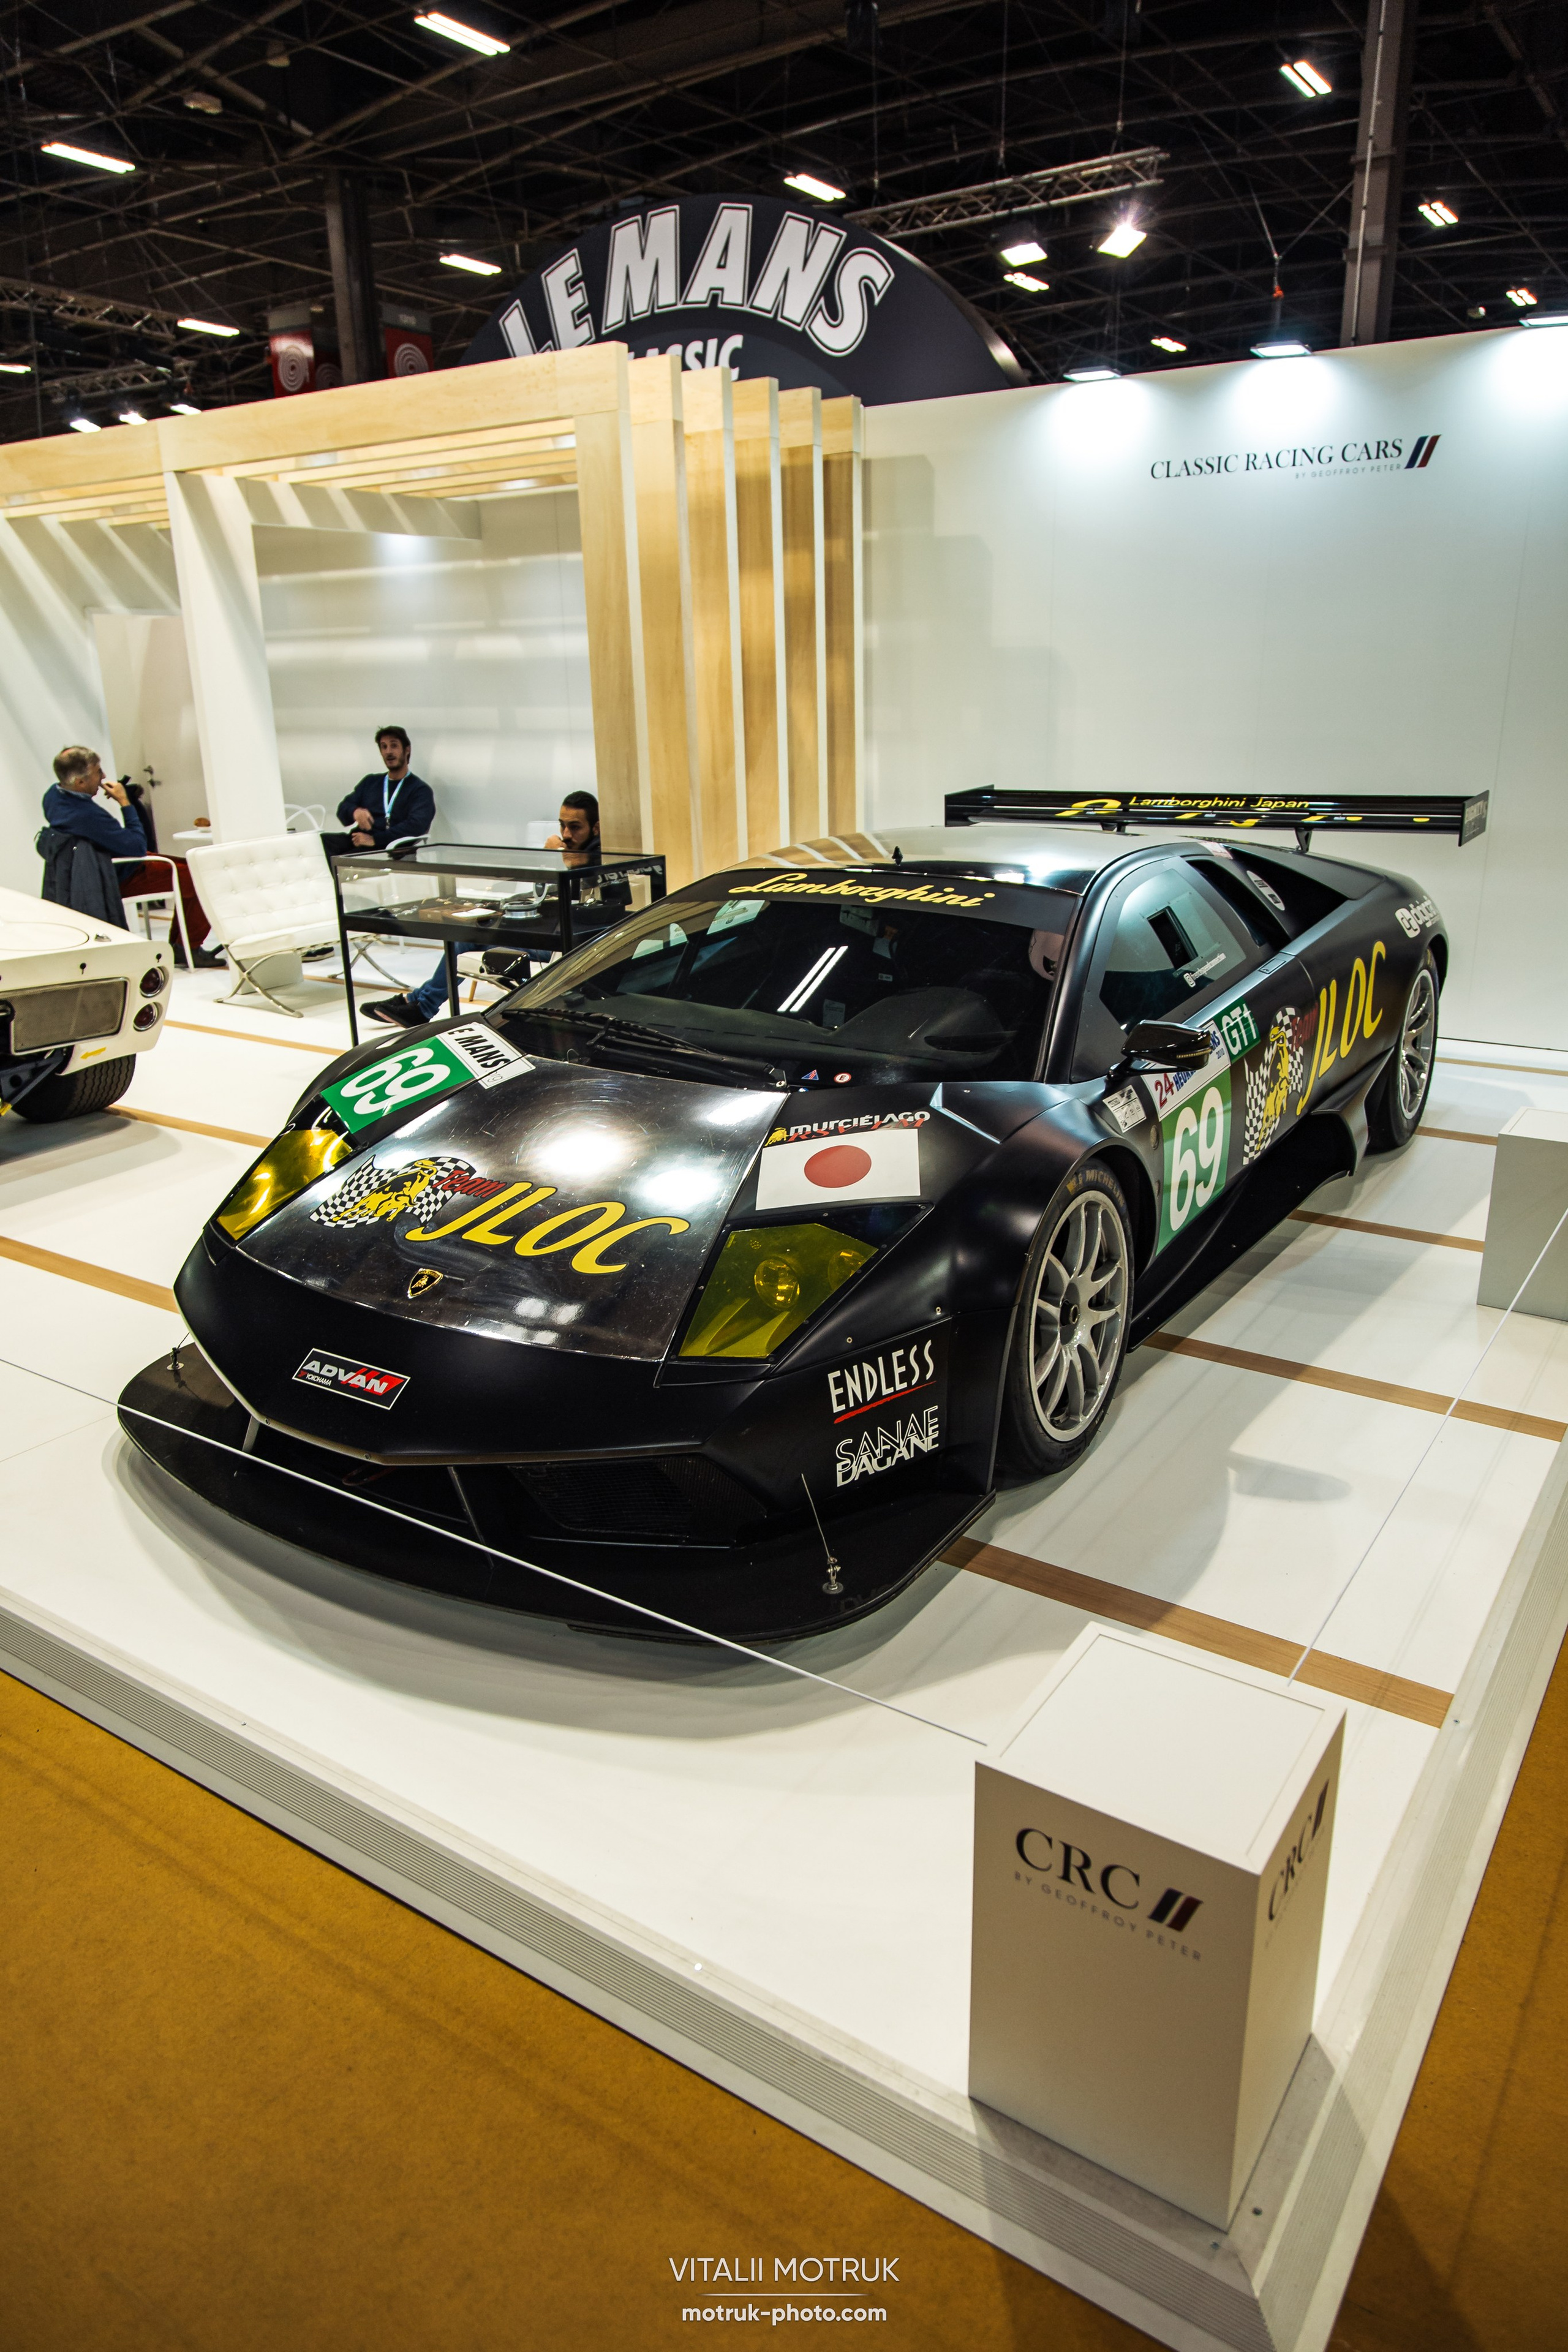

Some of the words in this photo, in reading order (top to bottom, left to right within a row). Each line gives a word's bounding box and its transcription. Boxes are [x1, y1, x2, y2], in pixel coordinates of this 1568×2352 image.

[499, 248, 596, 358] LE
[601, 203, 895, 357] MANS
[1150, 454, 1238, 479] CLASSIC
[1244, 445, 1333, 471] RACING
[1341, 439, 1403, 462] CARS
[1311, 467, 1366, 478] GEOFFROY
[1370, 464, 1401, 473] PETER
[1129, 796, 1246, 809] Lamborghini
[1250, 797, 1310, 809] Japan
[728, 873, 995, 908] Lamborghini
[454, 1035, 511, 1068] MANS
[1221, 1003, 1257, 1055] GT1
[1296, 941, 1386, 1116] JLOC
[340, 1047, 451, 1115] 69
[1155, 1072, 1175, 1109] 24
[1169, 1087, 1224, 1232] 69
[431, 1170, 507, 1198] Team
[1086, 1169, 1125, 1208] MICHELIN
[405, 1182, 690, 1274] JLOC
[303, 1360, 388, 1393] ADVAN
[306, 1373, 332, 1386] YOKOHAMA
[827, 1340, 934, 1413] ENDLESS
[835, 1405, 938, 1473] SANAE
[1016, 1828, 1140, 1910] CRC
[1014, 1871, 1033, 1886] BY
[1041, 1883, 1137, 1931] GEOFFROY
[1146, 1929, 1202, 1961] PETER
